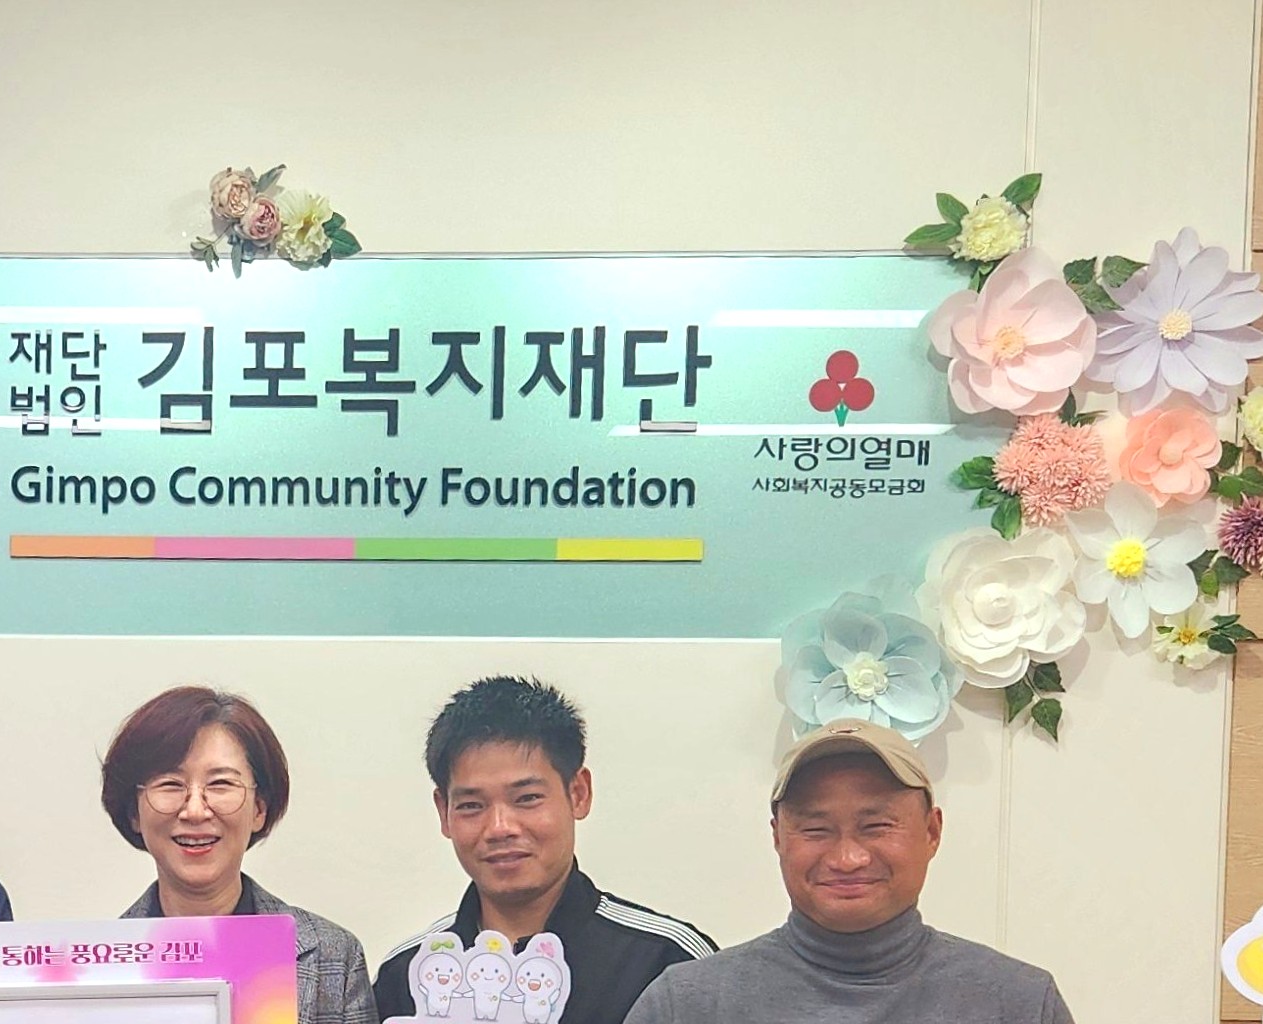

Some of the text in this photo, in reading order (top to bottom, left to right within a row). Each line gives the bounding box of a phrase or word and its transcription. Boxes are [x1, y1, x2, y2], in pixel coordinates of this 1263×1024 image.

[9, 329, 107, 381] 재단
[137, 325, 713, 437] 김포복지재단
[10, 384, 102, 436] 법인
[754, 436, 930, 472] 사랑의열매
[10, 465, 696, 517] Gimpo Community Foundation
[752, 477, 926, 499] 사회복지공동모금회
[2, 944, 66, 966] 통하는
[70, 942, 154, 964] 풍요로운
[161, 941, 203, 962] 김포
